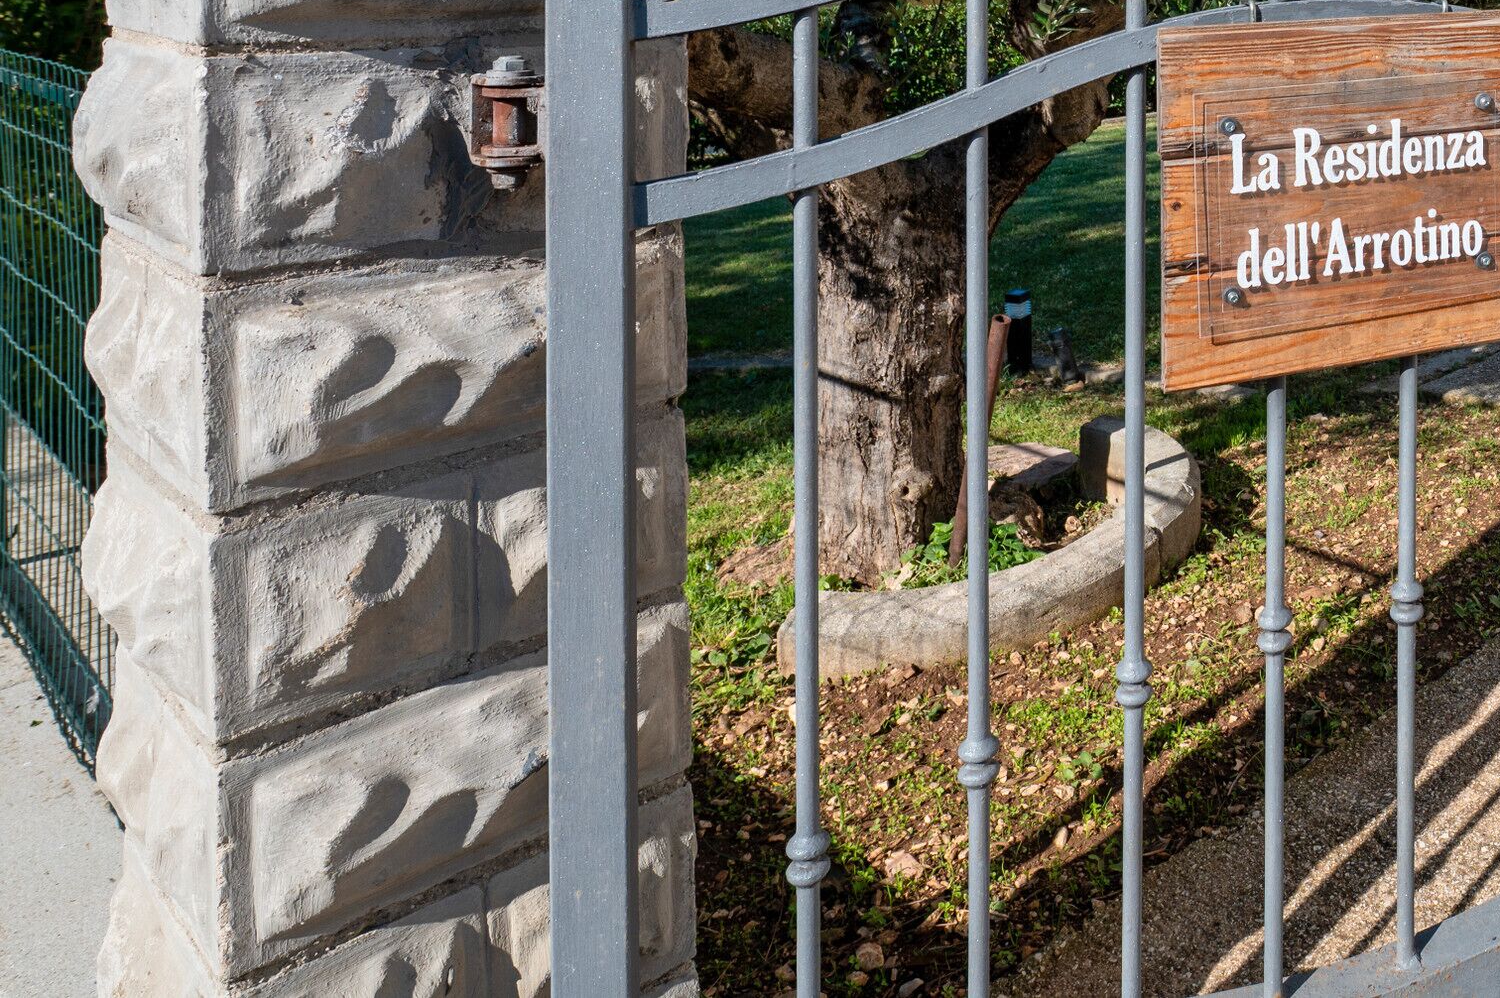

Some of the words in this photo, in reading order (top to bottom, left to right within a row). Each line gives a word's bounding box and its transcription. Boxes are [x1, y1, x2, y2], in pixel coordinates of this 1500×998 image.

[1229, 132, 1281, 195] La
[1292, 118, 1487, 187] Residenza
[1236, 208, 1484, 289] dell'Arrotino
